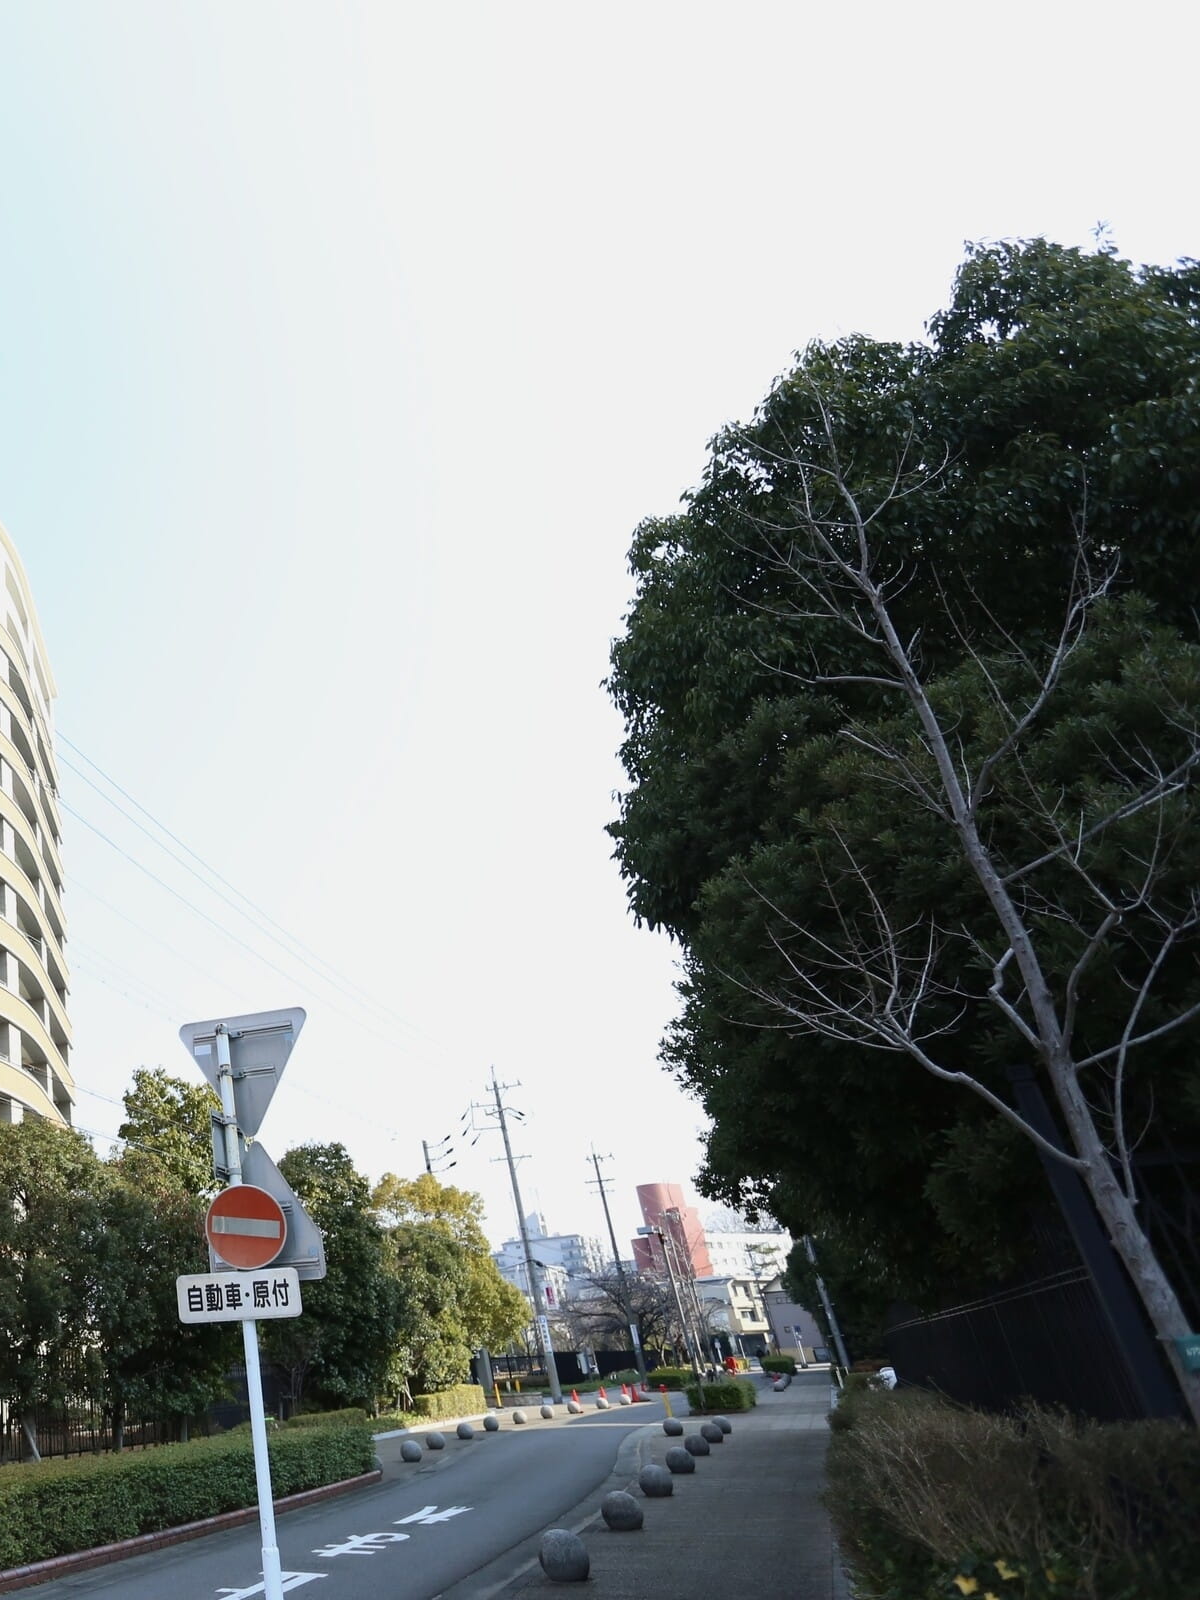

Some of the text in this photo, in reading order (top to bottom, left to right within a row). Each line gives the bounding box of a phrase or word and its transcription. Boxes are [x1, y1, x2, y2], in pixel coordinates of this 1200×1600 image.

[187, 1279, 289, 1312] 自動車・原付
